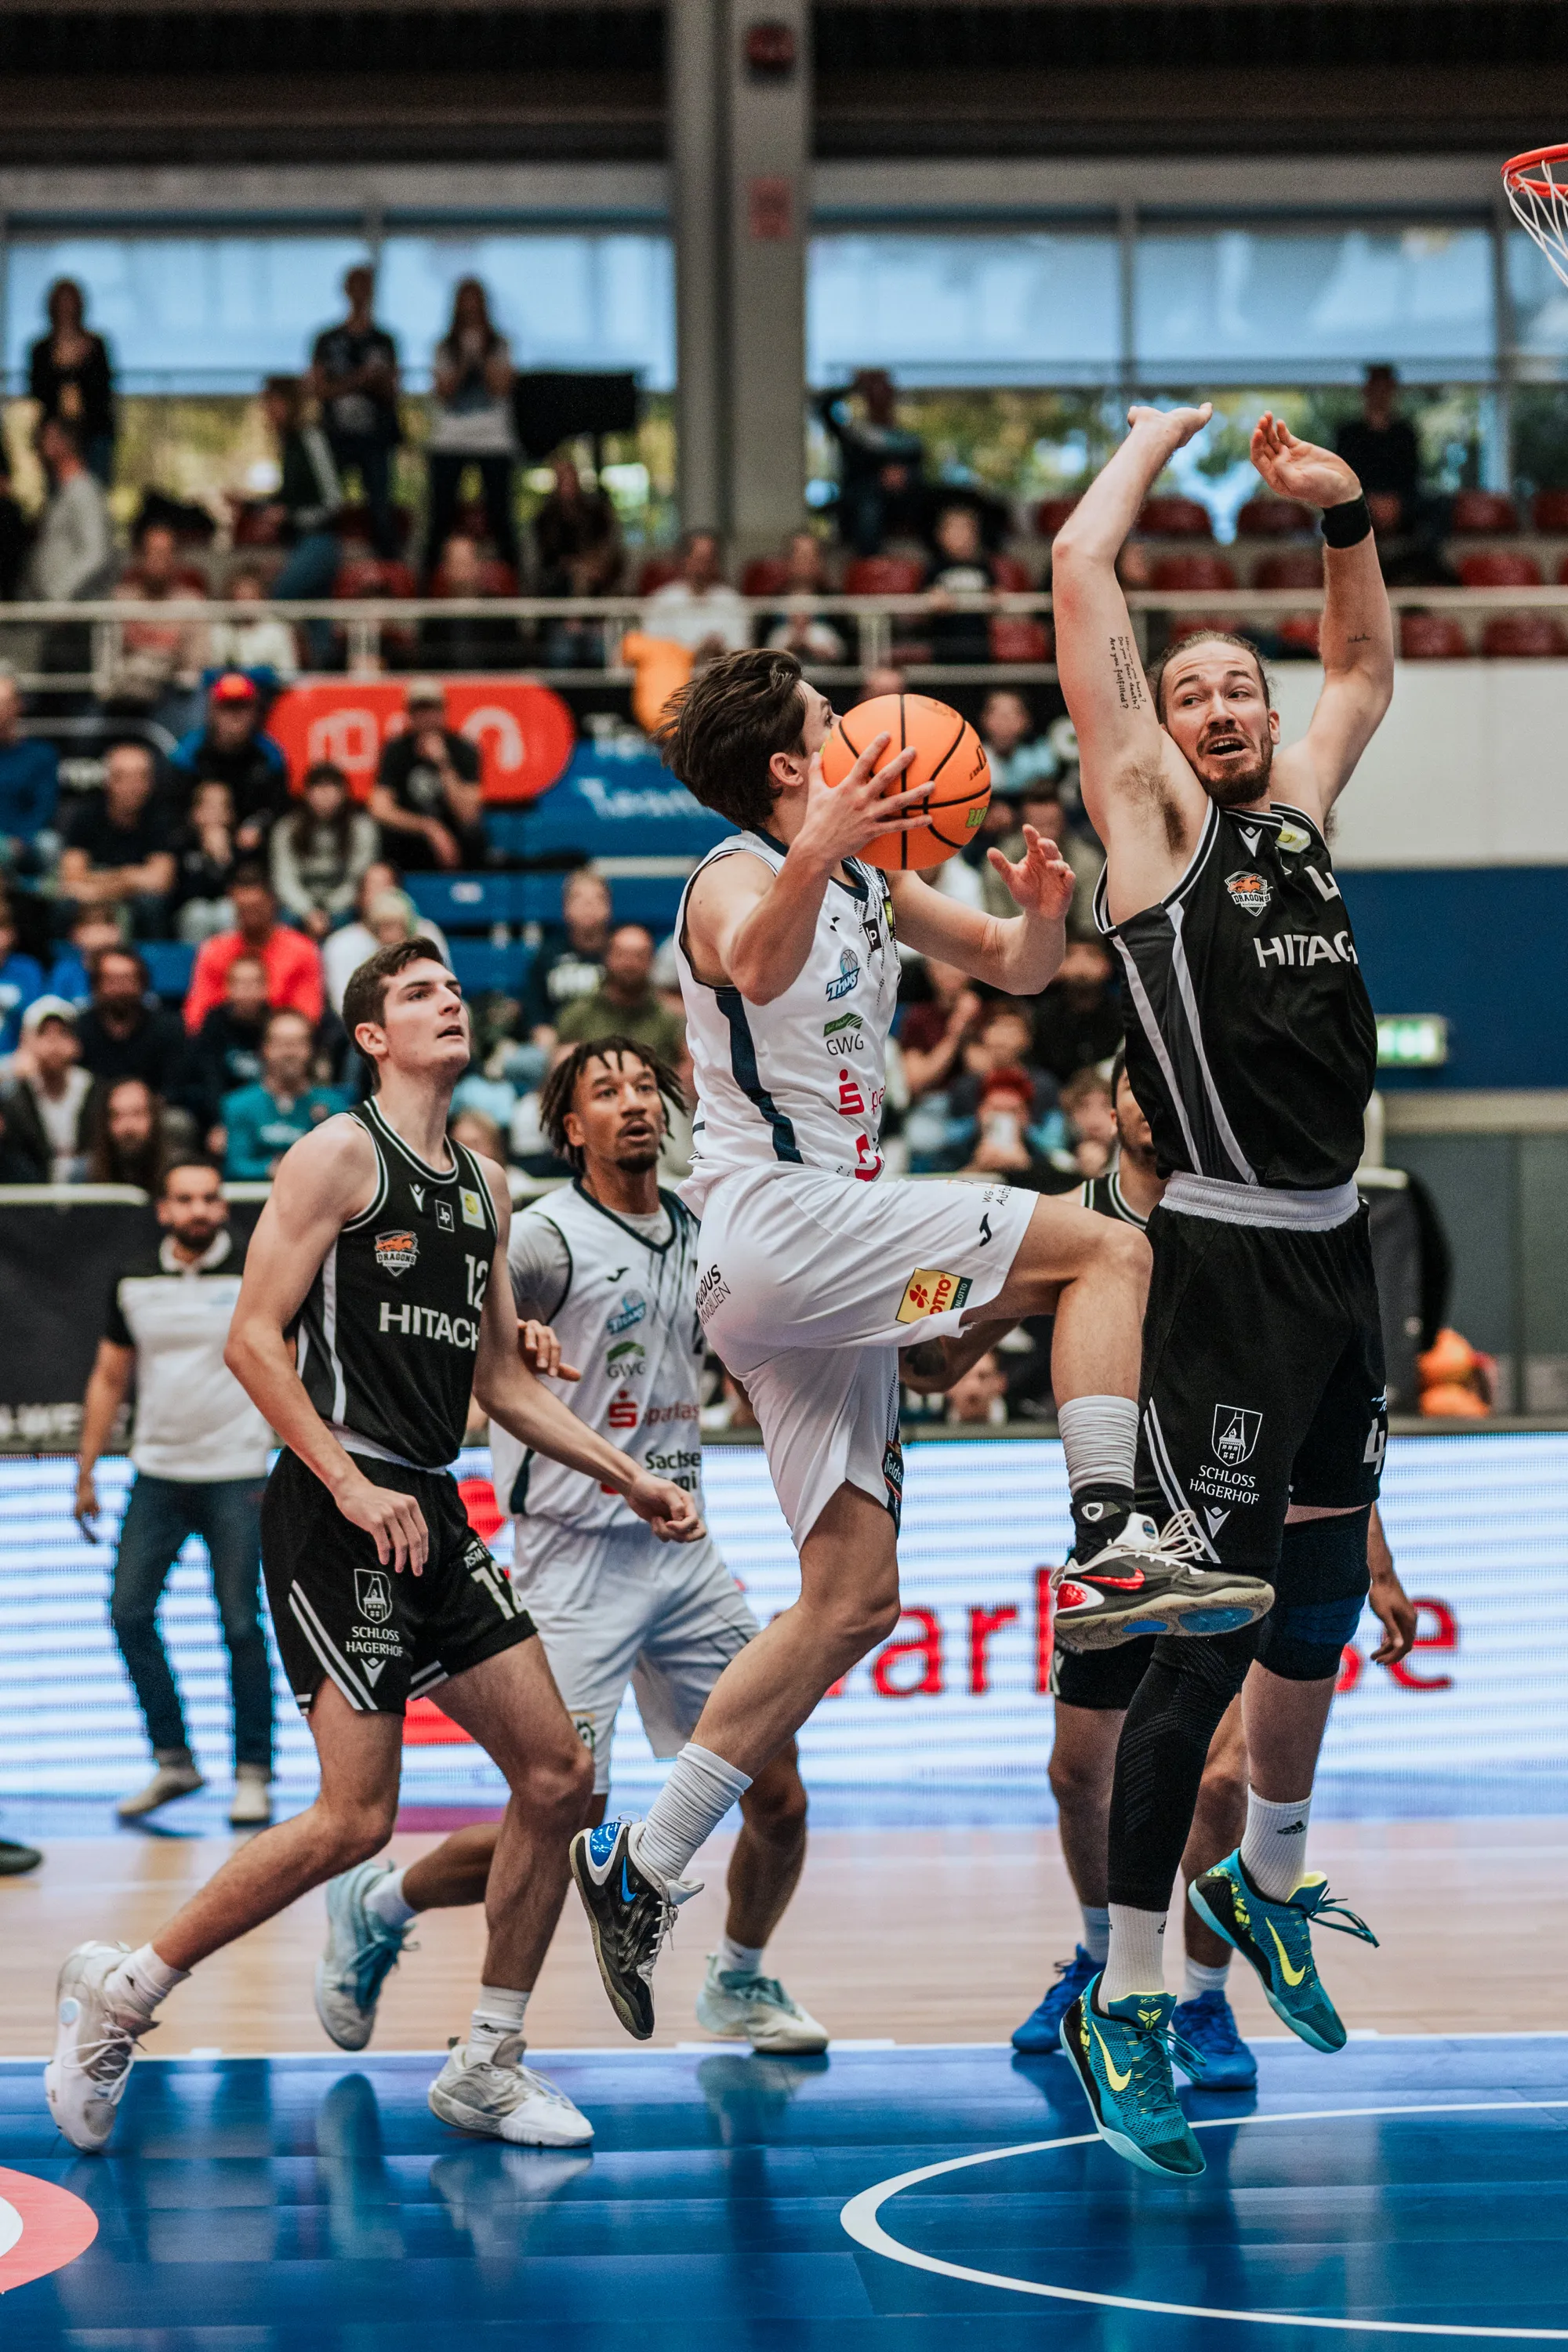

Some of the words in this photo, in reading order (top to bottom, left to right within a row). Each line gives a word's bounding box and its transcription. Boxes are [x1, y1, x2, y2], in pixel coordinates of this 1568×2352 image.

[1110, 653, 1120, 667] you
[1233, 894, 1270, 903] DRAGONS
[826, 1033, 864, 1055] GWG
[377, 1253, 416, 1263] DRAGONS
[465, 1254, 489, 1312] 12
[1363, 1417, 1386, 1475] 4
[1198, 1465, 1256, 1488] SCHLOSS
[1189, 1479, 1259, 1504] HAGERHOF
[351, 1626, 400, 1642] SCHLOSS
[346, 1641, 403, 1657] HAGERHOF
